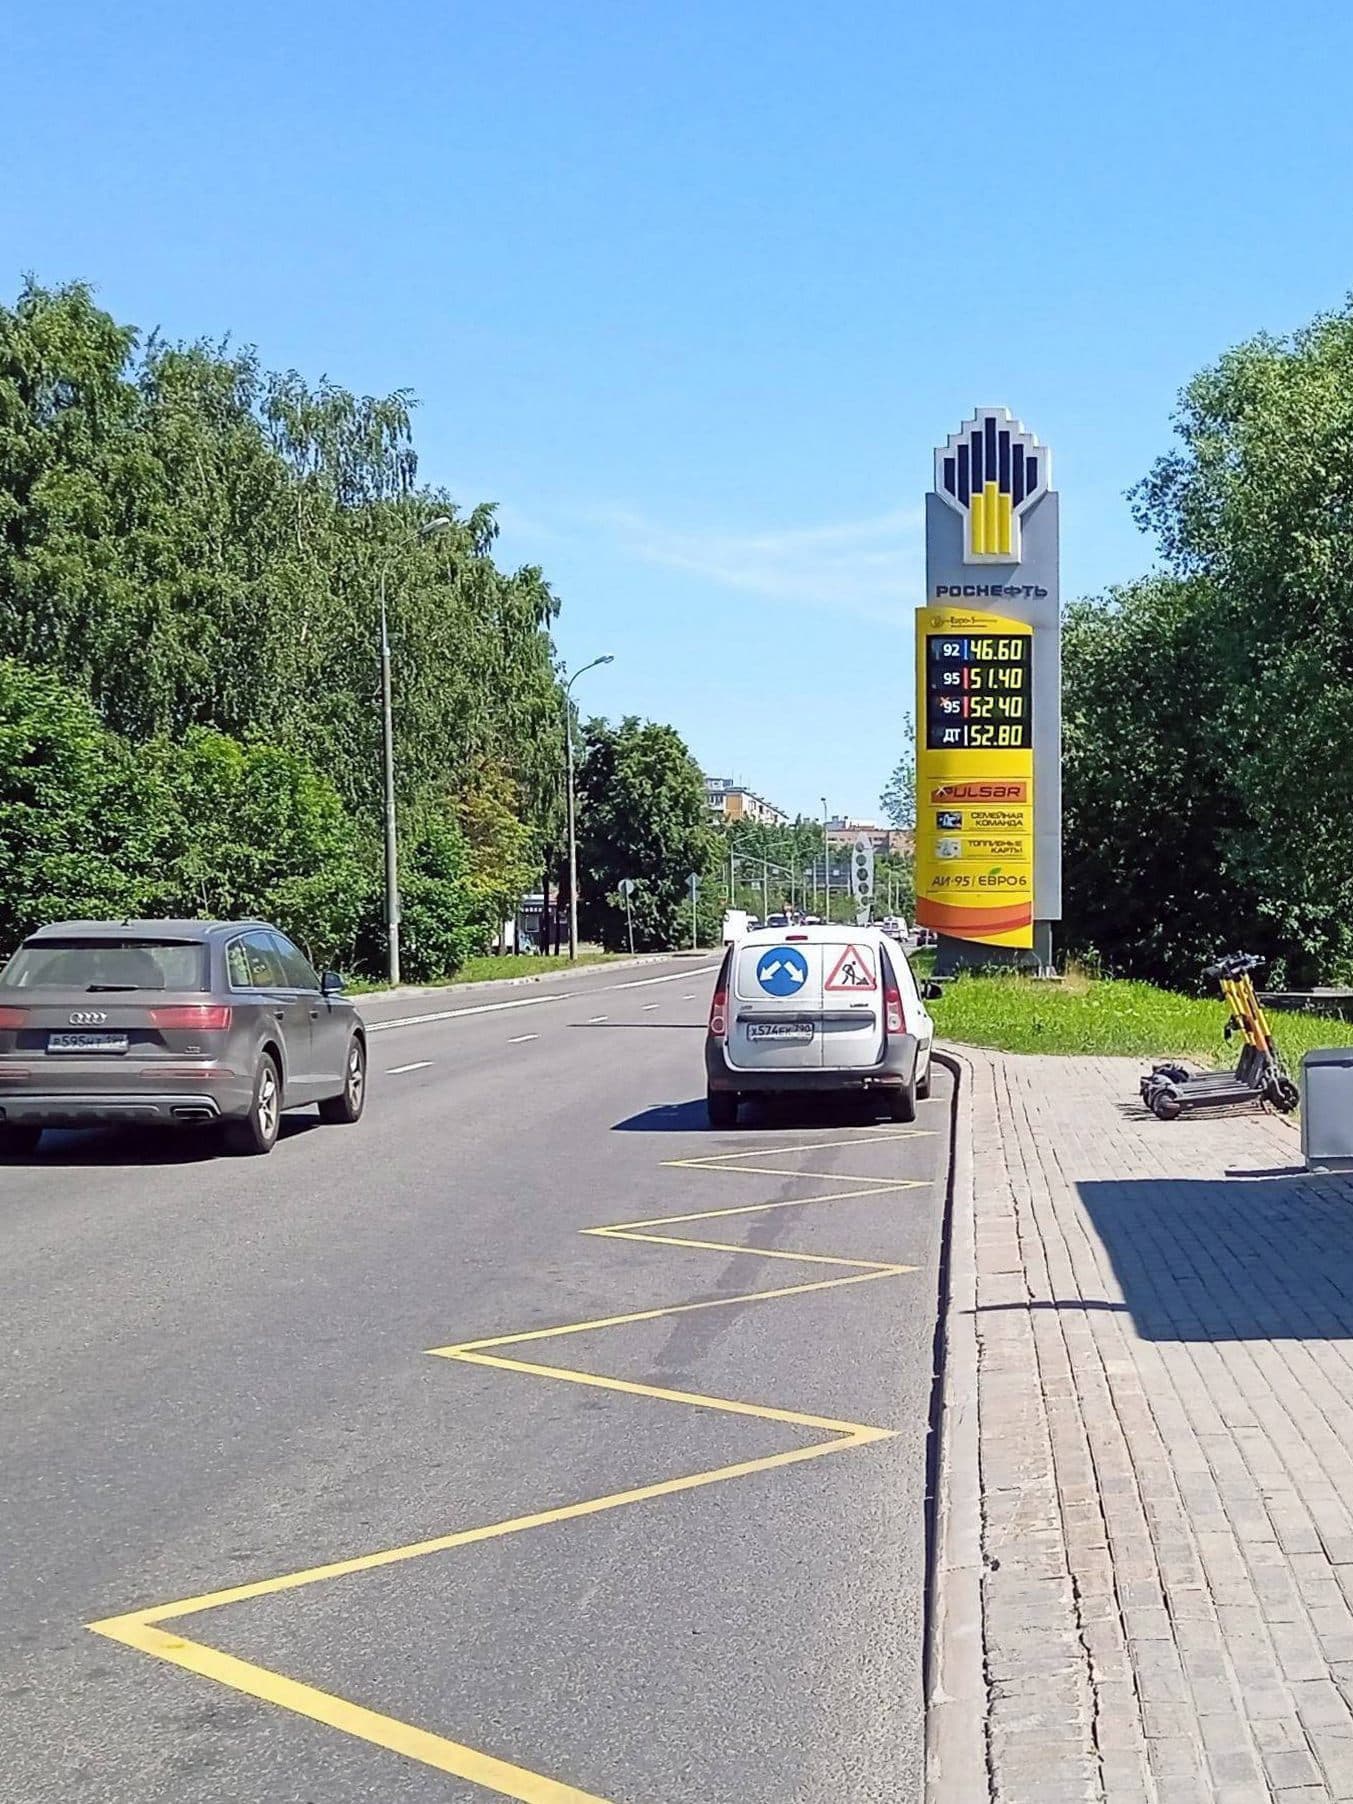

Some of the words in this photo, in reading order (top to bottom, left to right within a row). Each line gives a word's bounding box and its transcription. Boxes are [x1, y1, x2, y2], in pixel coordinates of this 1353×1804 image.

[936, 584, 1048, 598] РОСНЕФТЬ
[943, 643, 961, 657] 92
[970, 639, 1022, 660] 46.60
[943, 672, 961, 685] 95
[970, 668, 1022, 689] 51.40
[943, 700, 961, 714] 95
[970, 696, 1022, 718] 5240
[943, 729, 961, 743] ДТ
[970, 725, 1022, 746] 52.80
[975, 819, 1023, 827] КОМАНДА
